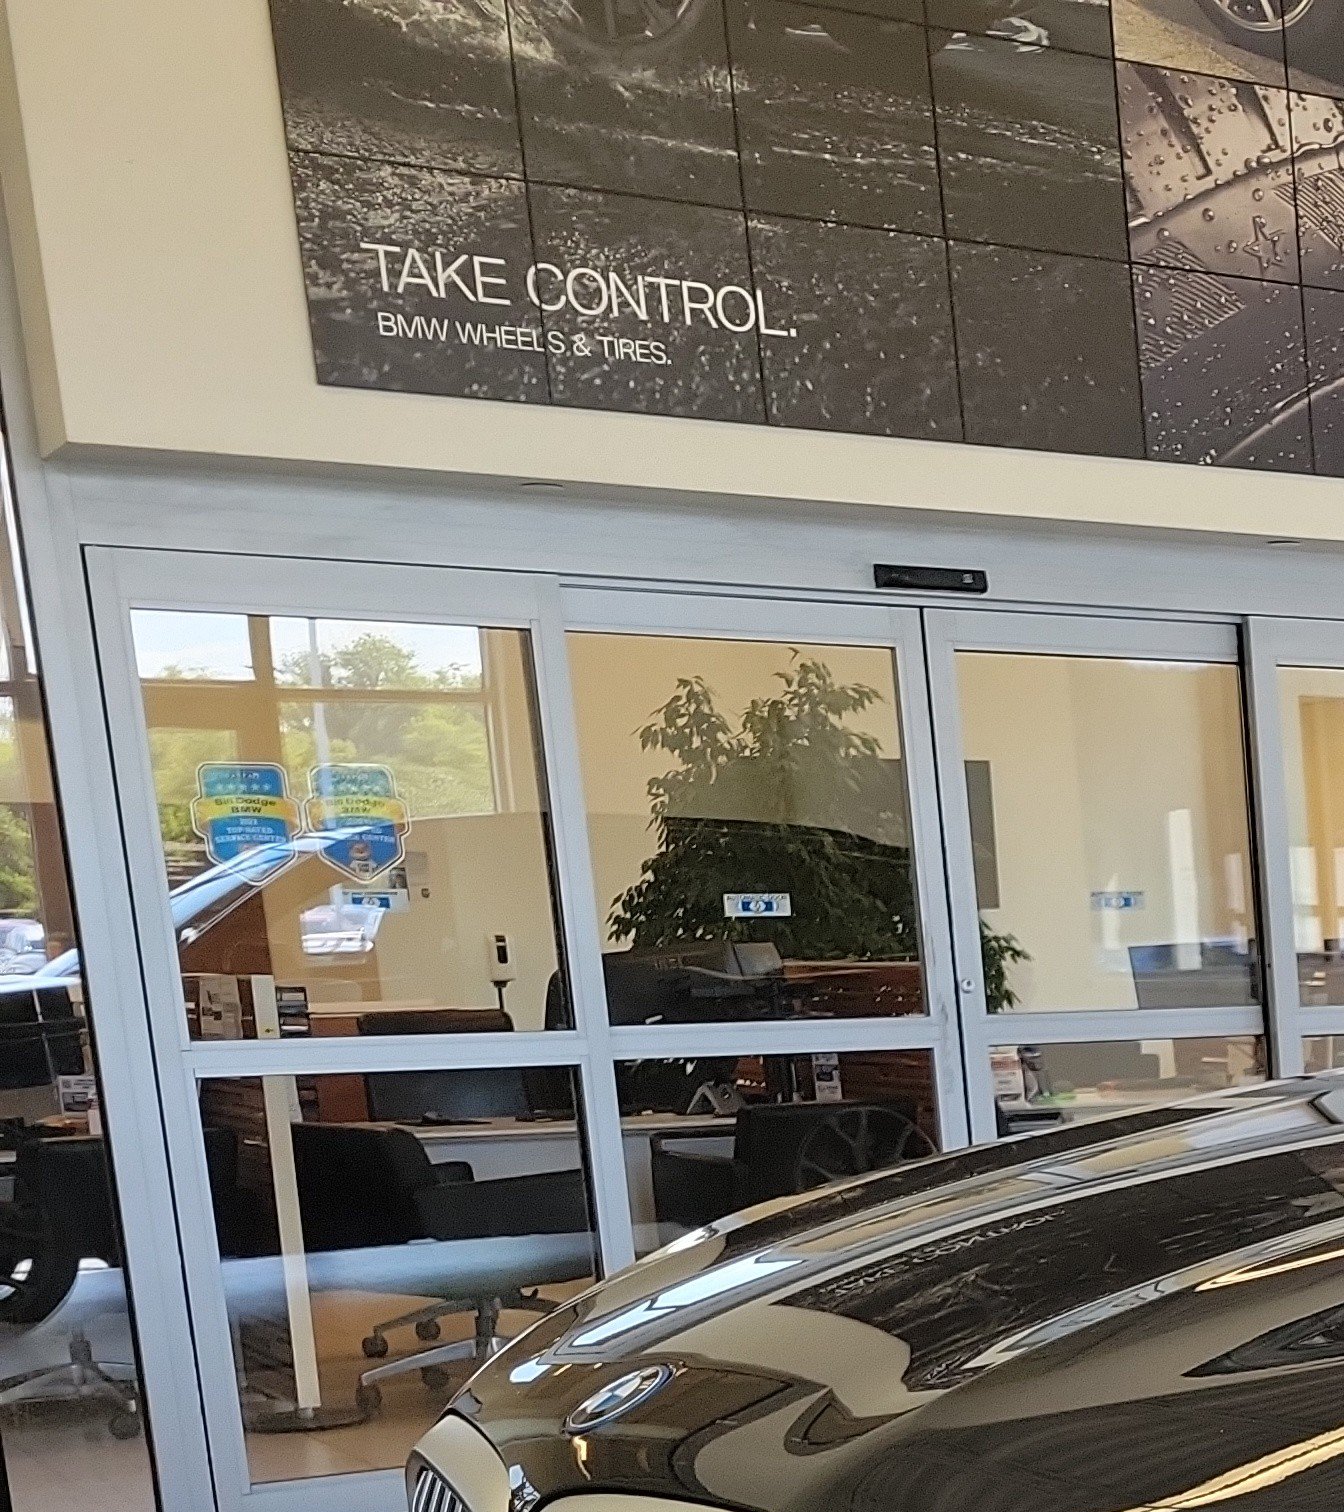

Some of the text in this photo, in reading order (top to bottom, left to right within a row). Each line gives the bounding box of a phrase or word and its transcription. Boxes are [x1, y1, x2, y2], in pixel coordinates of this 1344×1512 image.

[360, 242, 797, 337] TAKE CONTROL.
[377, 311, 673, 366] BMW WHEELS & TIRES.
[236, 797, 277, 806] Dodge
